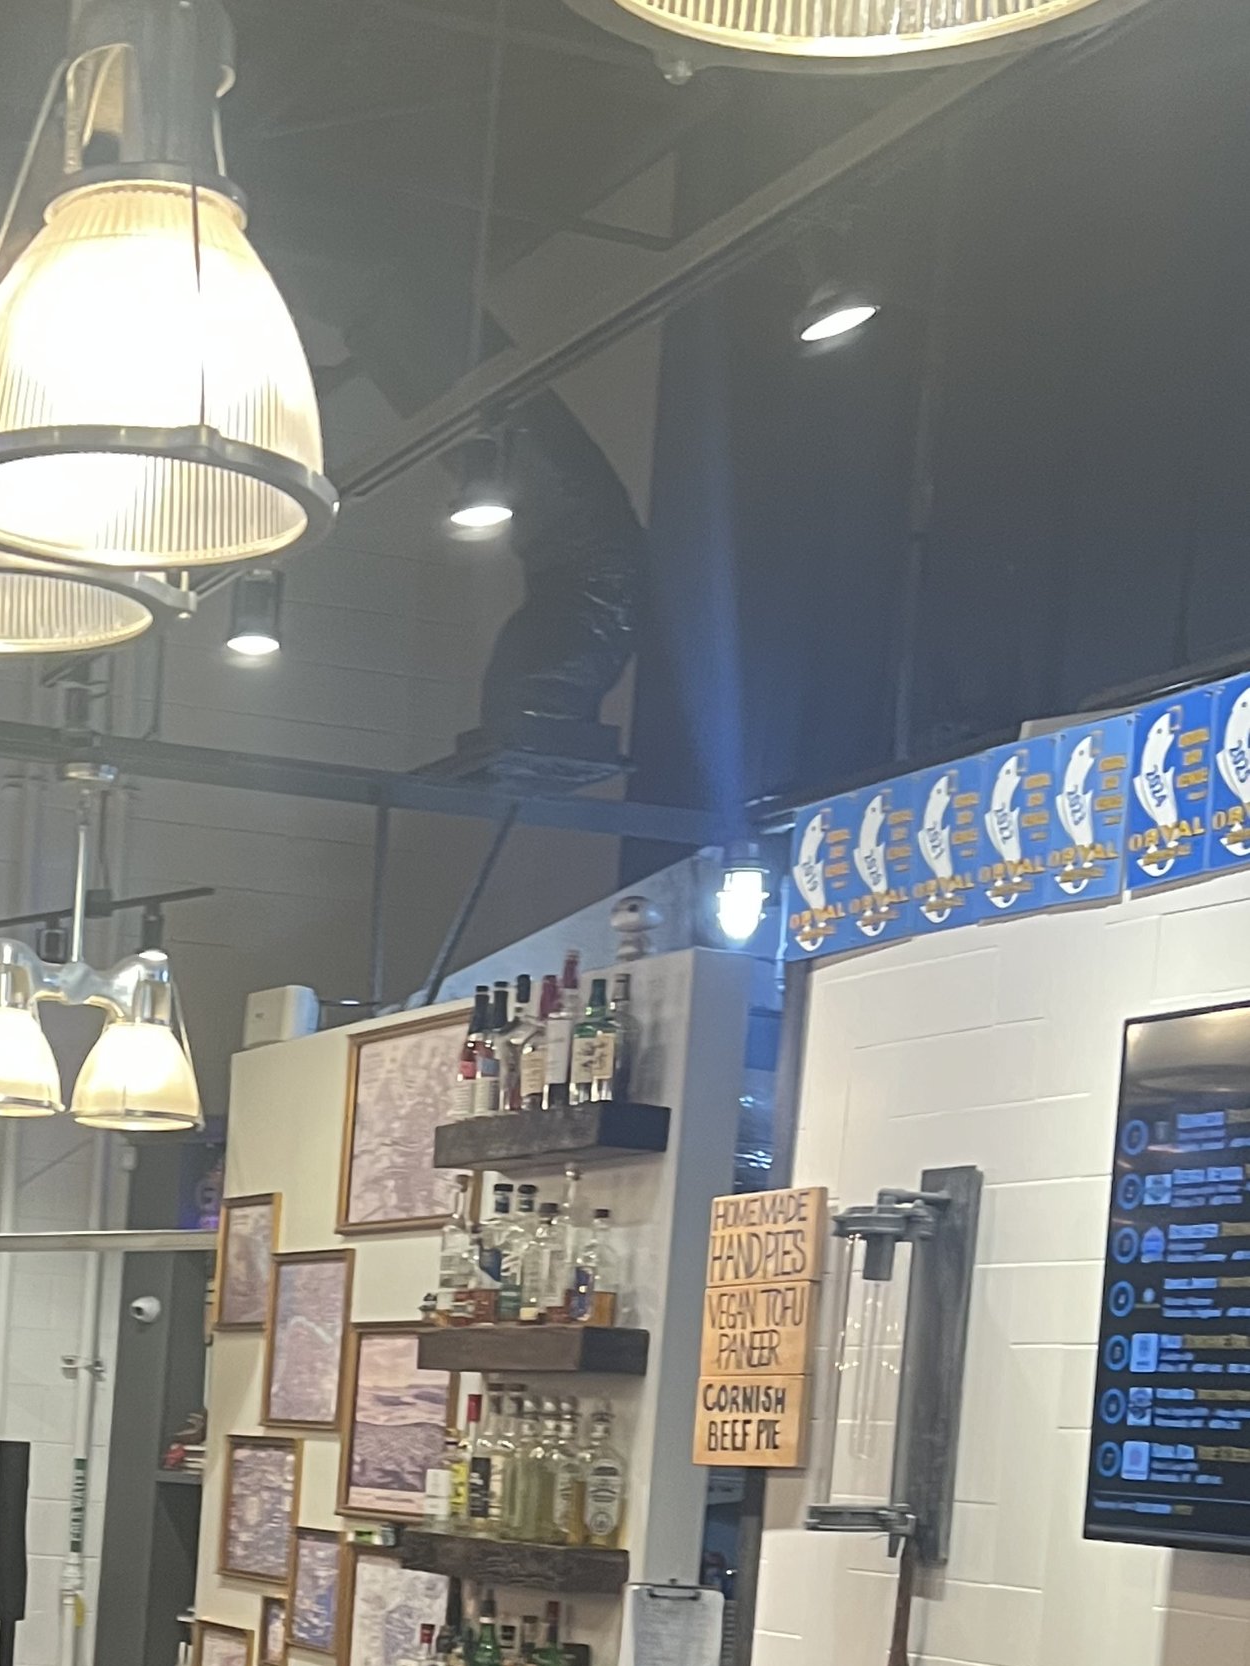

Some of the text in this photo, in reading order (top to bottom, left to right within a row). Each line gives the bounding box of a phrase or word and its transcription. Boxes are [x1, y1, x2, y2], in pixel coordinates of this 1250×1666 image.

[1130, 816, 1205, 851] ORVAL
[981, 859, 1045, 882] ORVAL
[1049, 845, 1119, 868] ORVAL
[851, 888, 909, 914] ORVAL
[915, 875, 974, 898] ORVAL
[791, 904, 846, 929] ORVAL
[715, 1193, 808, 1231] HOMEMADE
[711, 1231, 805, 1282] HAND PIES
[709, 1286, 806, 1329] VEGAN TOFU
[716, 1330, 781, 1370] PANEER
[703, 1383, 787, 1414] CORNISH
[707, 1418, 781, 1452] BEEF PIE
